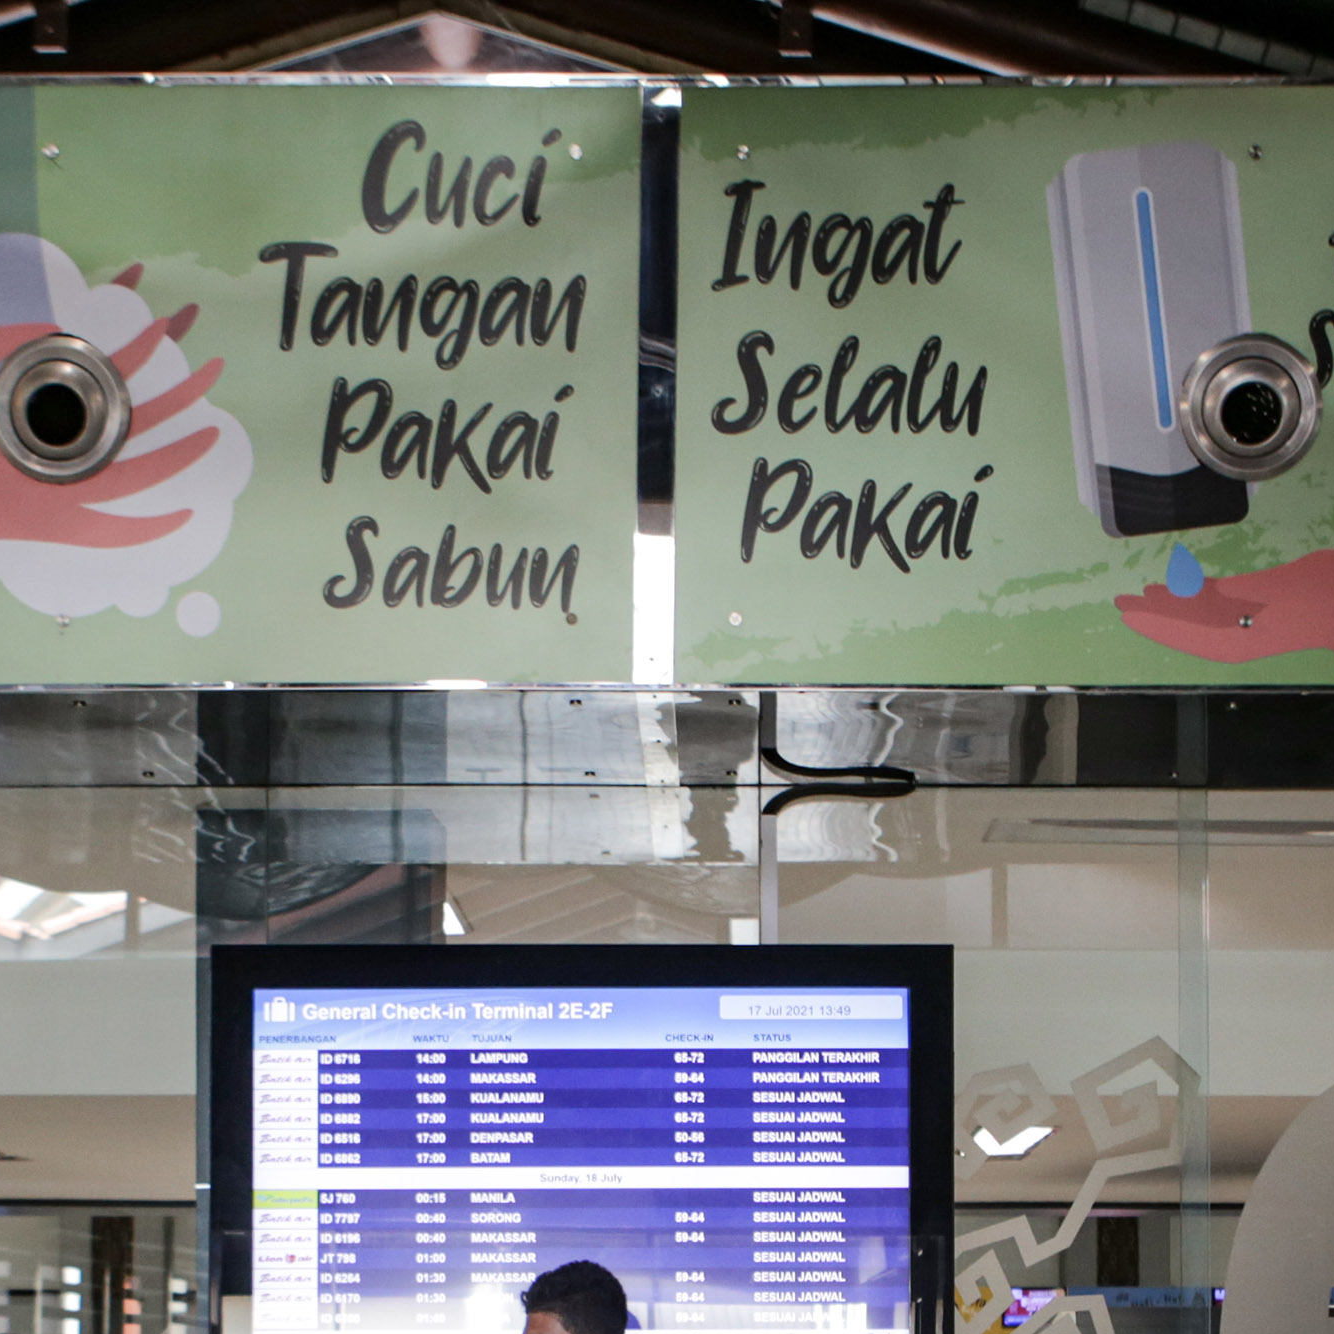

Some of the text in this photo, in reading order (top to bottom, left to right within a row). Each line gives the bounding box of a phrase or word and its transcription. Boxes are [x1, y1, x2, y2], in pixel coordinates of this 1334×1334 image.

[362, 120, 562, 235] Cuci
[711, 178, 966, 309] Ingat
[260, 241, 587, 370] Tangan
[711, 330, 989, 437] Selalu
[321, 376, 575, 494] Pakai
[740, 456, 995, 574] Pakai
[322, 515, 580, 613] Sabun
[302, 1002, 613, 1020] General Check-in Terminal 2E-2F
[749, 1005, 851, 1016] 17 Jul 2021 13:49
[259, 1035, 337, 1043] PENERBANGAN
[413, 1035, 449, 1043] WAKTU
[665, 1034, 714, 1042] CHECK-IN
[753, 1034, 791, 1042] STATUS
[320, 1054, 333, 1064] ID
[416, 1053, 446, 1064] 14:00
[471, 1053, 527, 1063] LAMPUNG
[675, 1052, 705, 1063] 65-72
[753, 1052, 819, 1062] PANGGILAN
[822, 1052, 880, 1062] TERAKHIR
[320, 1072, 880, 1084] ID 14:00 MAKASSAR PANGGILAN TERAKHIR
[320, 1093, 333, 1104] ID
[471, 1093, 543, 1103] KUALANAMU
[675, 1092, 705, 1103] 65-72
[753, 1092, 795, 1102] SESUAI
[797, 1092, 845, 1102] JADWAL
[320, 1112, 845, 1124] ID 17:00 KUALANAMU 65-72 SESUAI JADWAL
[320, 1131, 845, 1144] ID 17:00 DENPASAR SESUAI JADWAL
[320, 1152, 845, 1164] ID 17:00 BATAM 65-72 SESUAI JADWAL
[586, 1173, 598, 1182] 18
[601, 1173, 623, 1184] July
[471, 1193, 515, 1203] MANILA
[753, 1191, 795, 1202] SESUAI
[797, 1191, 845, 1202] JADWAL
[320, 1213, 333, 1224] ID
[416, 1213, 446, 1223] 00:40
[471, 1213, 521, 1223] SORONG
[753, 1212, 795, 1222] SESUAI
[797, 1212, 845, 1222] JADWAL
[320, 1233, 333, 1244] ID
[416, 1233, 446, 1243] 00:40
[471, 1233, 536, 1243] MAKASSAR
[753, 1232, 795, 1242] SESUAI
[797, 1232, 845, 1242] JADWAL
[320, 1254, 335, 1264] JT
[416, 1253, 446, 1264] 01:00
[471, 1253, 536, 1264] MAKASSAR
[753, 1252, 795, 1263] SESUAI
[797, 1252, 845, 1263] JADWAL
[320, 1274, 333, 1284] ID
[416, 1273, 446, 1284] 01:30
[471, 1273, 536, 1283] MAKASSAR
[753, 1272, 795, 1282] SESUAI
[797, 1272, 845, 1282] JADWAL
[320, 1294, 333, 1304] ID
[753, 1292, 795, 1303] SESUAI
[797, 1292, 845, 1303] JADWAL
